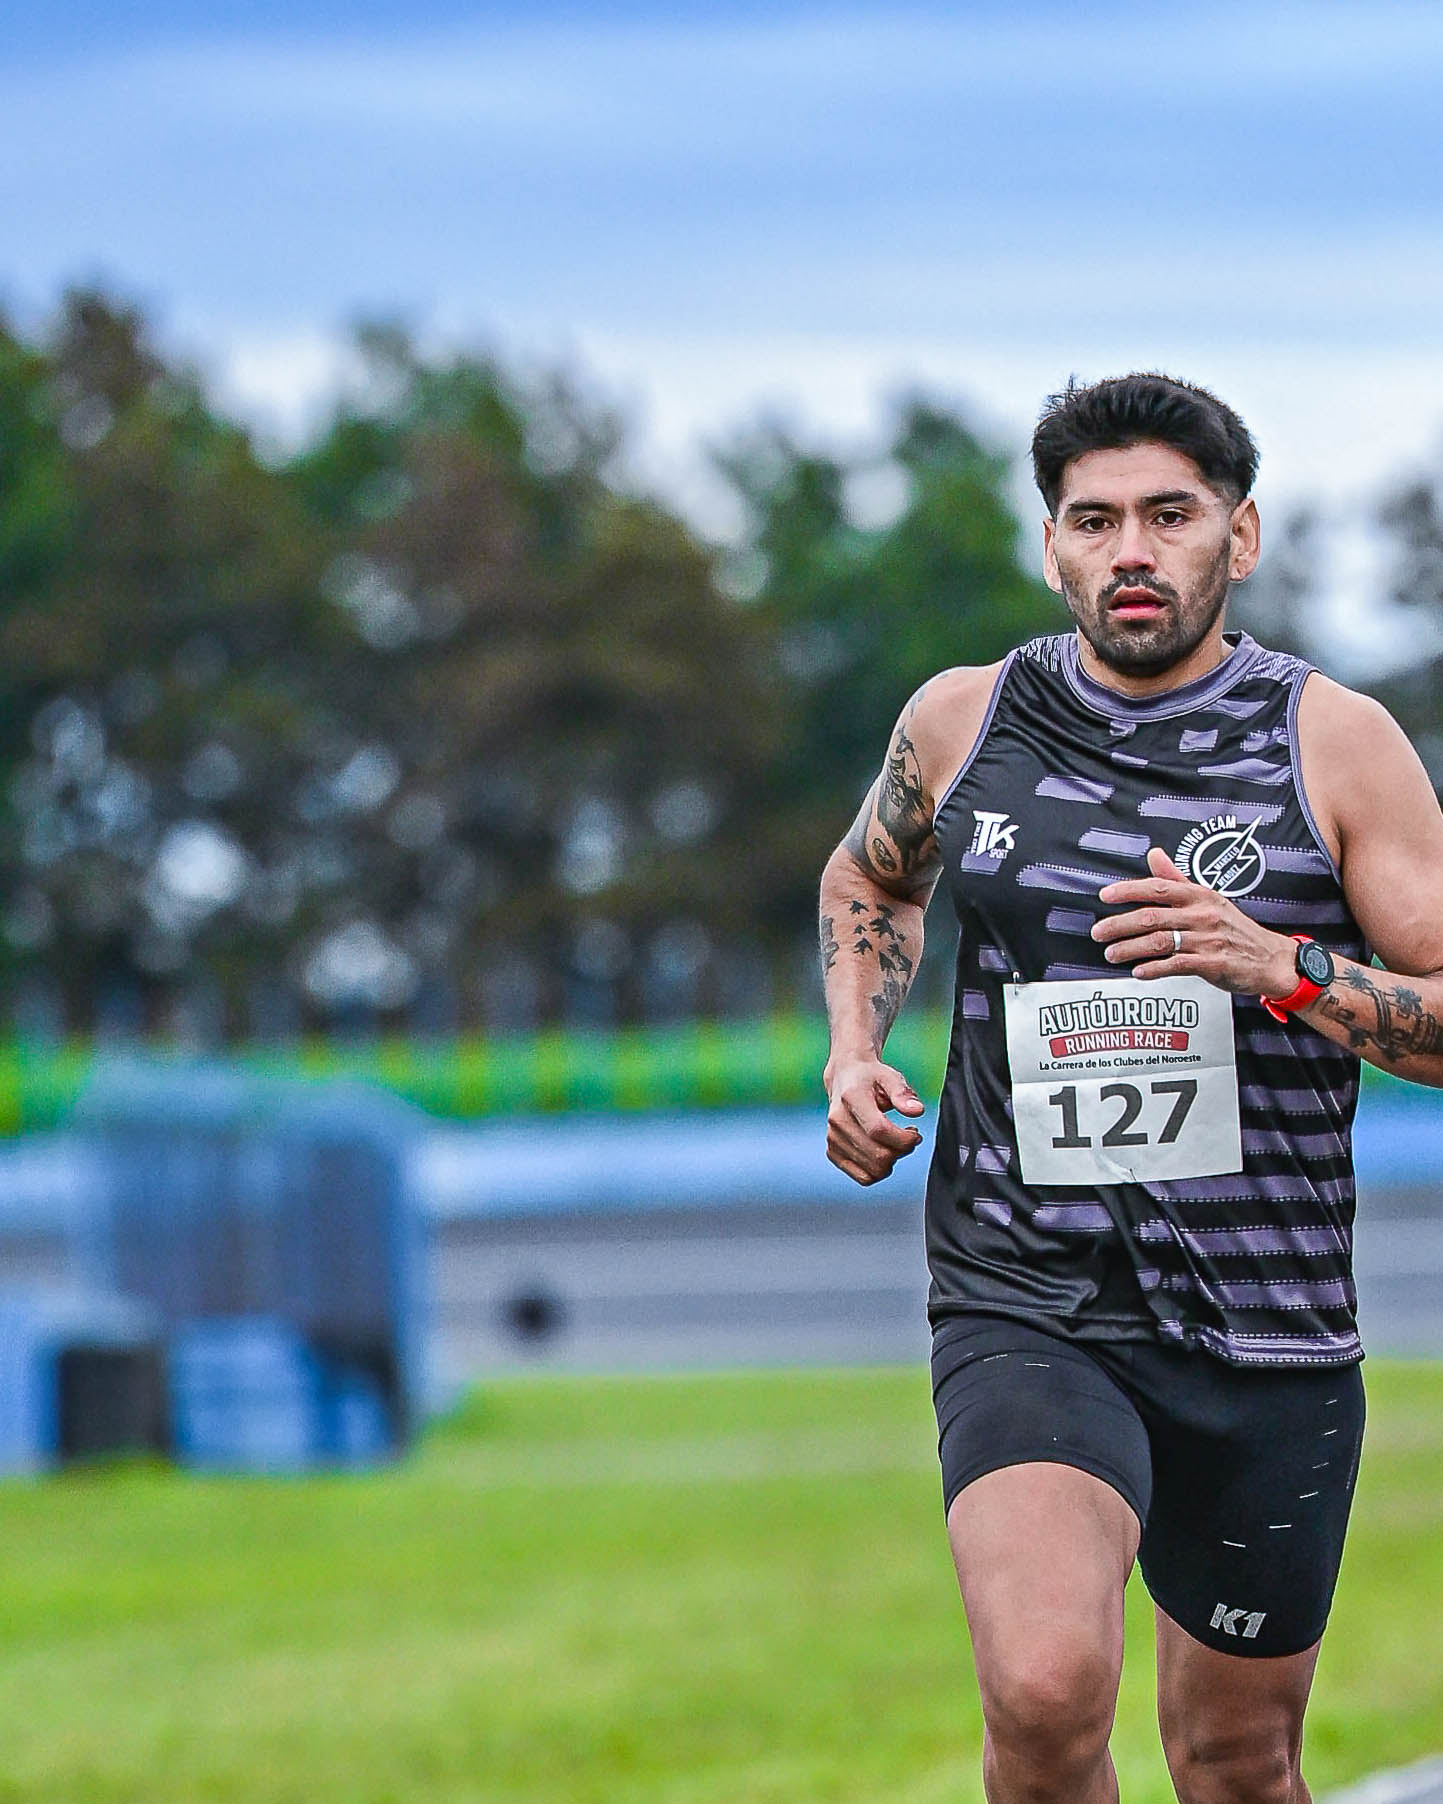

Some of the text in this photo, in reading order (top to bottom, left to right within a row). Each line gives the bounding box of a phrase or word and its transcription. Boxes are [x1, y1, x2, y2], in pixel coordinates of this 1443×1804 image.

[972, 810, 1020, 857] TK
[1200, 816, 1236, 834] TEAM
[989, 848, 1009, 859] SPORT
[1039, 991, 1199, 1036] AUTÓDROMO
[1064, 1031, 1173, 1054] RUNNING RACE
[1039, 1054, 1202, 1071] La Carrera de los Clubes del Noroeste
[1048, 1079, 1198, 1149] 127
[1209, 1602, 1267, 1638] K1
